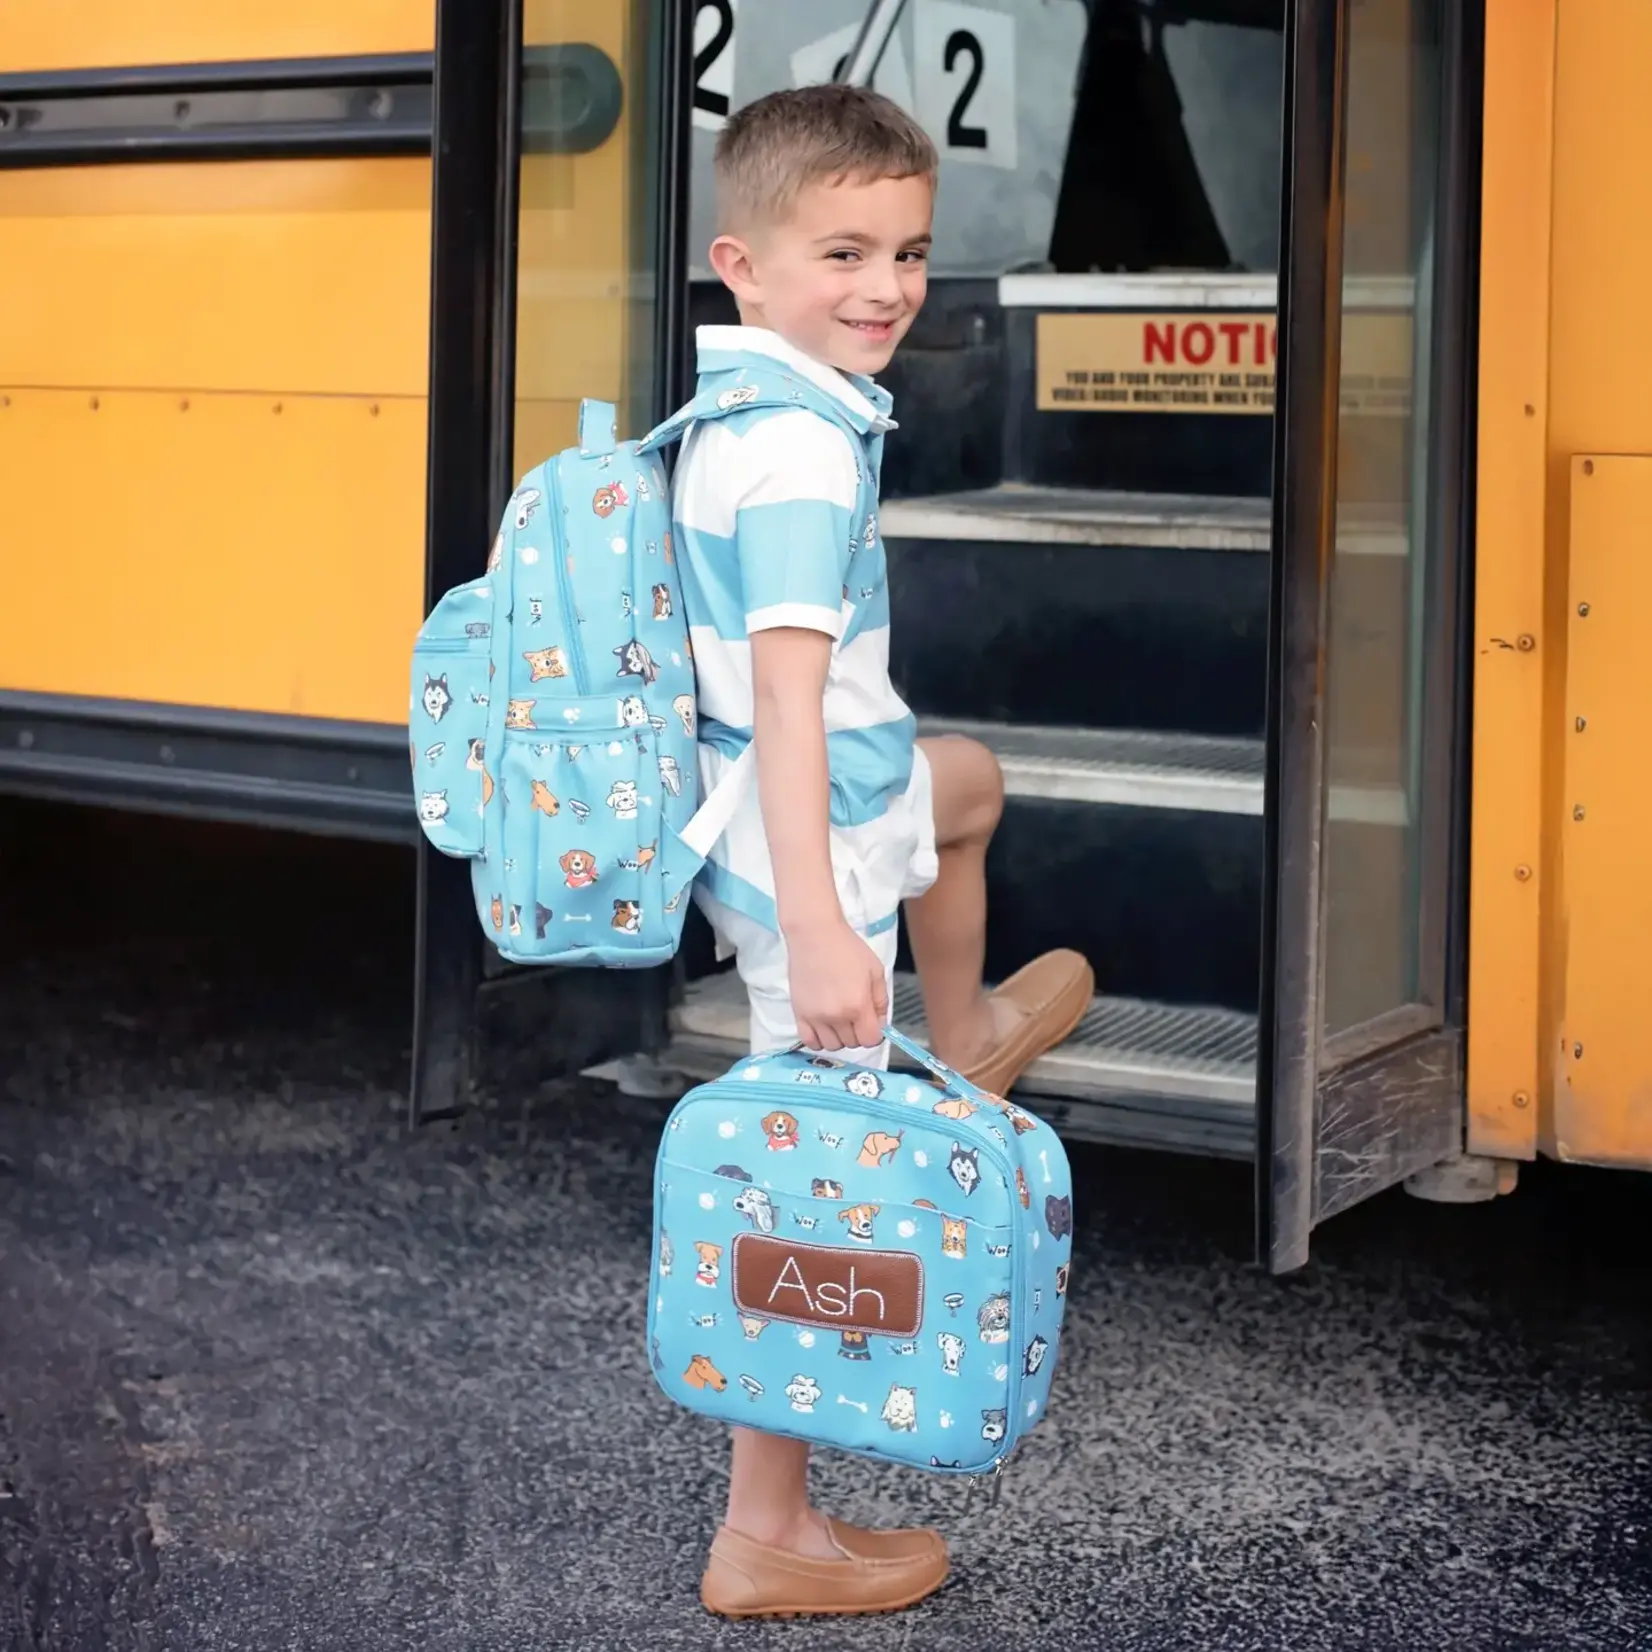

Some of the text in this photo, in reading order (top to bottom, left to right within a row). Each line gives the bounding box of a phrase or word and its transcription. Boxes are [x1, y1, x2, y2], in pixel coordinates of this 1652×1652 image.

[944, 29, 987, 148] 2
[1143, 321, 1277, 366] NOTI
[767, 1256, 885, 1321] Ash
